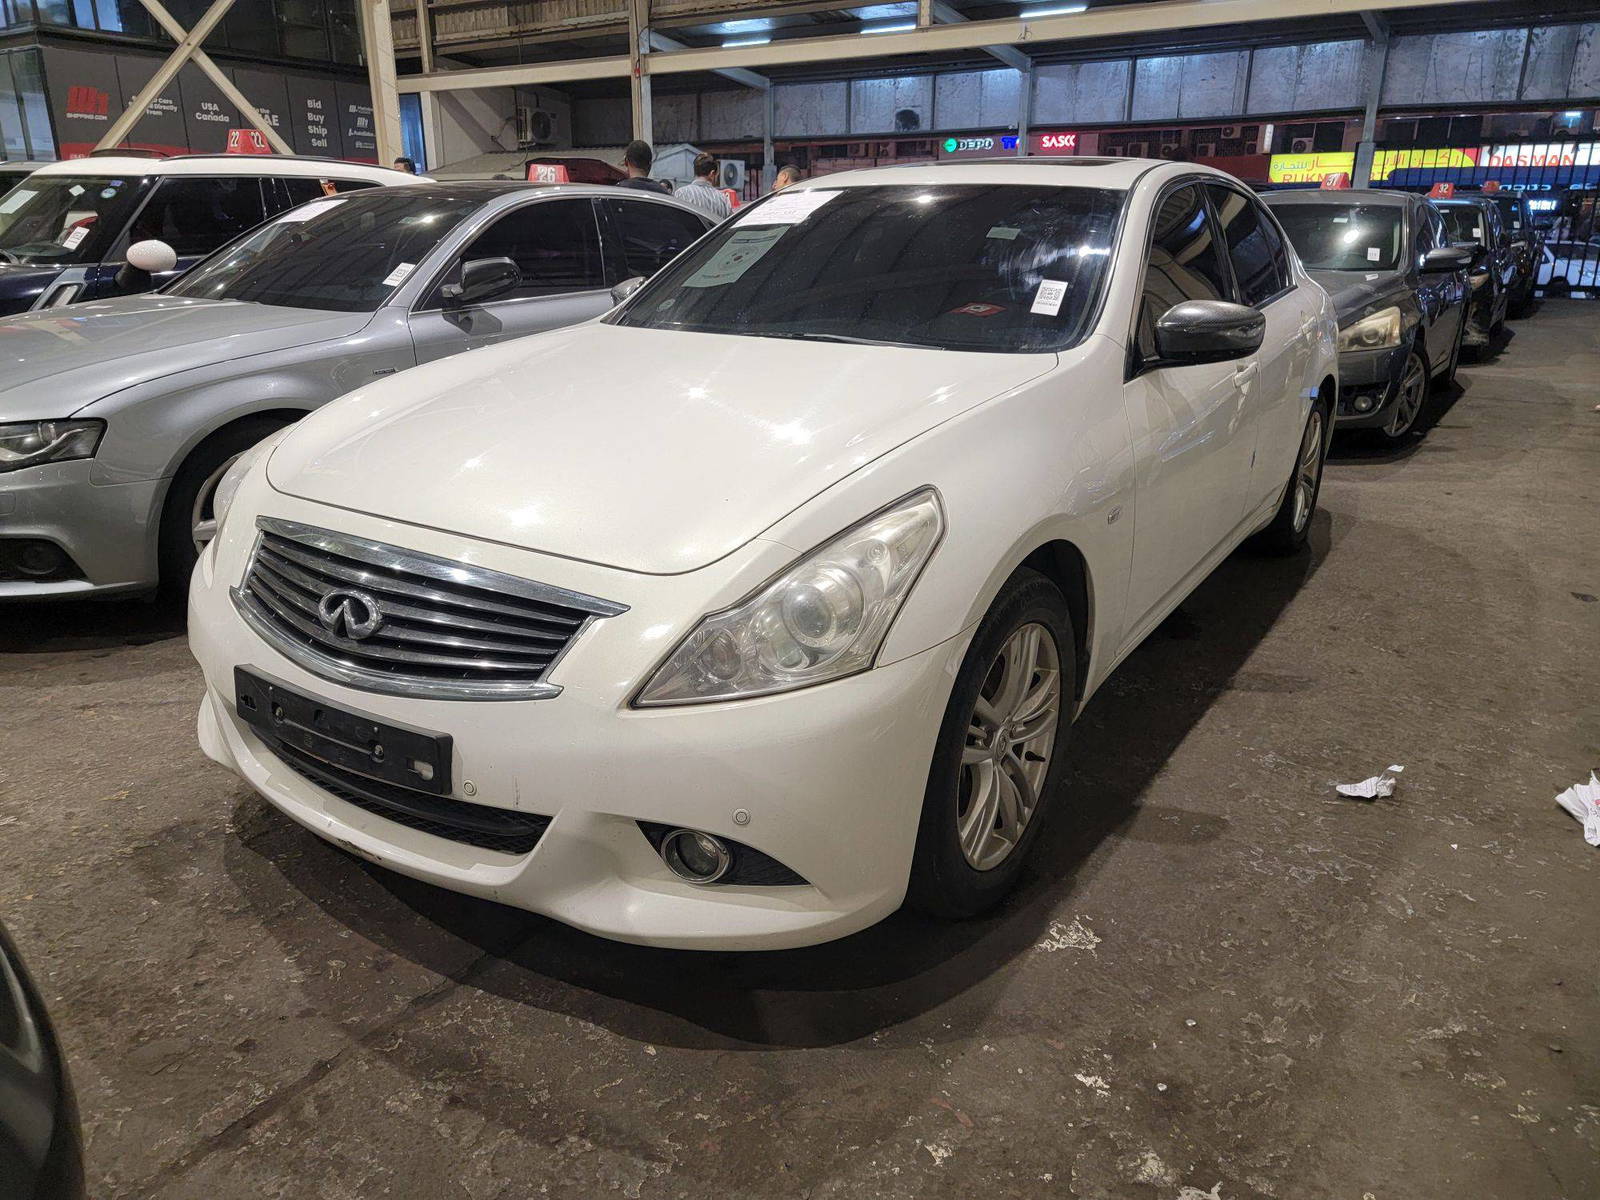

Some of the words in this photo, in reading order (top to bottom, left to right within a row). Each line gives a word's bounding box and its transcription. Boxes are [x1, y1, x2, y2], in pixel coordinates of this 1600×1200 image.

[201, 103, 219, 111] USA
[307, 99, 322, 109] Bid
[195, 112, 230, 122] Canada
[307, 112, 325, 124] Buy
[308, 125, 328, 137] Ship
[230, 131, 240, 147] 22
[249, 131, 265, 148] 22
[311, 138, 327, 147] Sell
[1490, 154, 1575, 168] DASMAN
[537, 167, 556, 183] 26
[1438, 184, 1449, 193] 32
